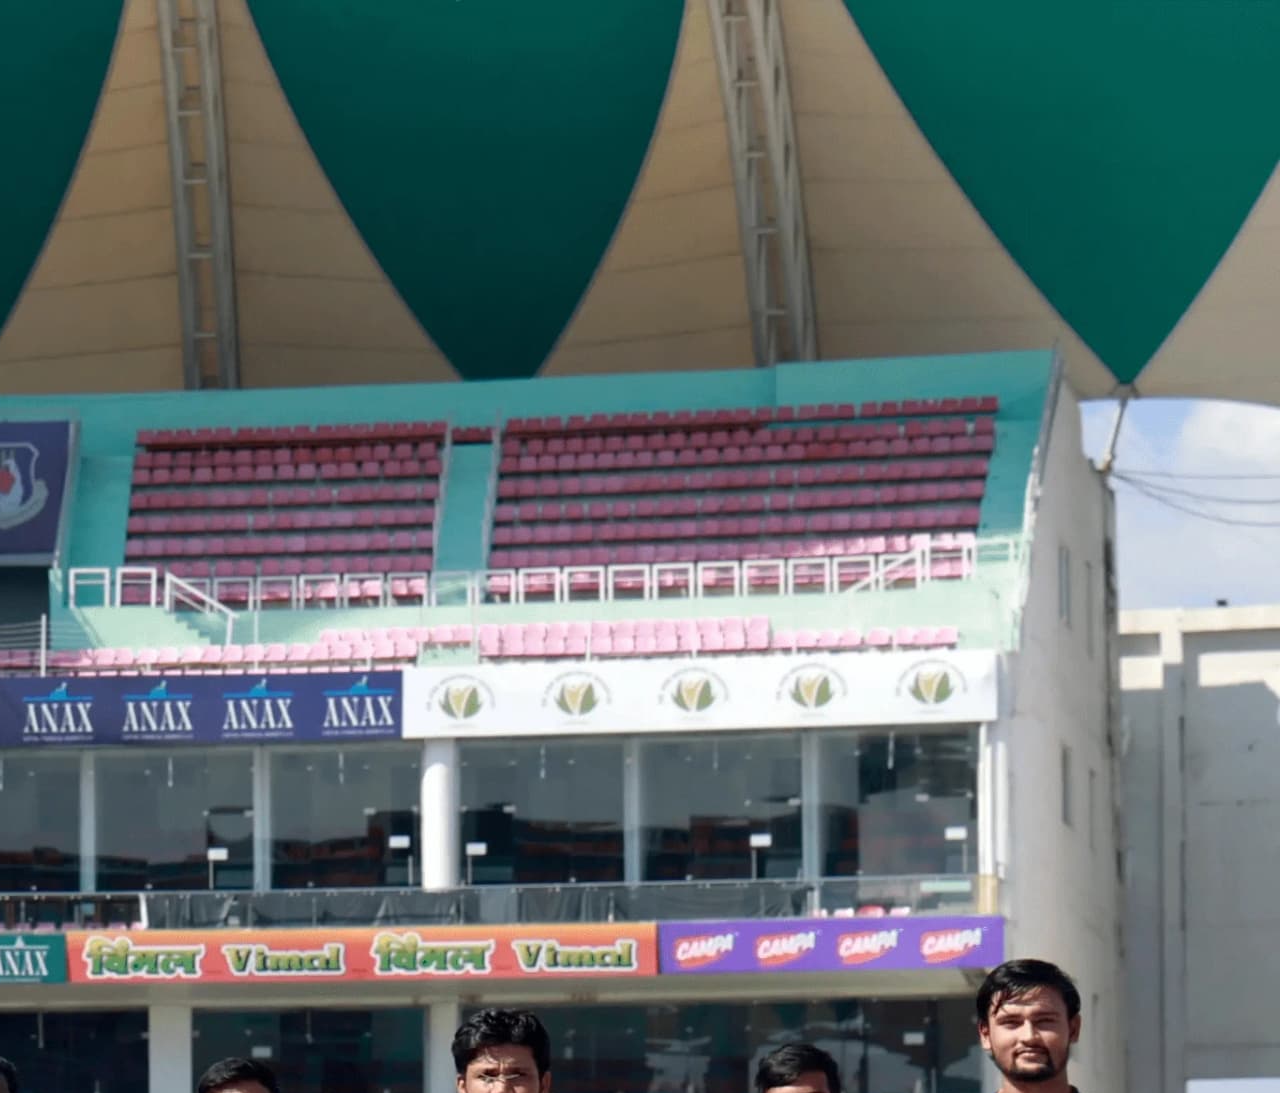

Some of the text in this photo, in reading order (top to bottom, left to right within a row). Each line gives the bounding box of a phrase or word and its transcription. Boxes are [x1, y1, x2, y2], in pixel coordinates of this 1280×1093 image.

[23, 702, 93, 733] ANAX
[123, 701, 192, 731] ANAX
[222, 698, 293, 729] ANAX
[323, 696, 394, 727] ANAX
[676, 928, 982, 960] CAMPA CAMPA CAMPA CAMPA
